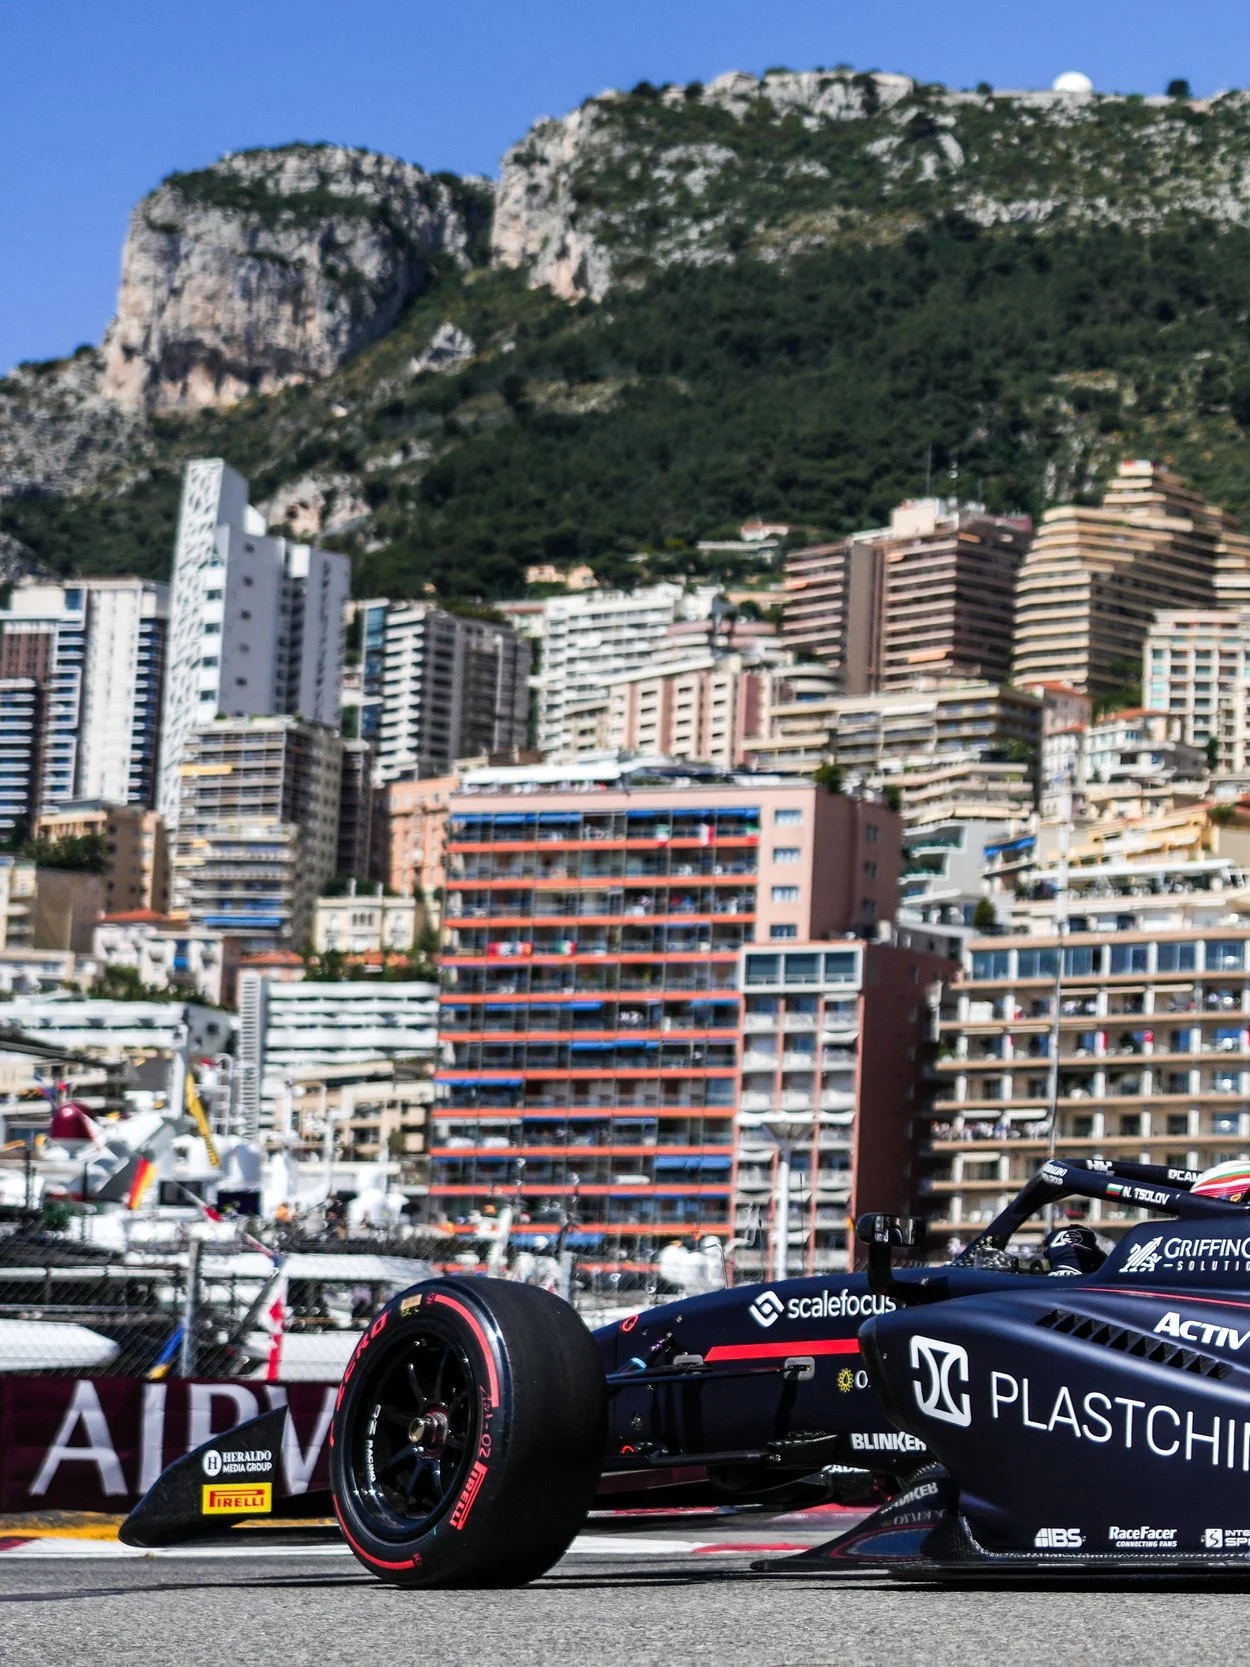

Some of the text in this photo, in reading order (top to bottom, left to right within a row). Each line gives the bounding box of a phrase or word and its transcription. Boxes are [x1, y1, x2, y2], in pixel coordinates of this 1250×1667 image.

[1122, 1185, 1132, 1198] N.
[1133, 1187, 1170, 1205] TSOLOV
[787, 1288, 897, 1319] scalefocus
[221, 1450, 272, 1463] HERALDO
[222, 1462, 273, 1473] MEDIA GROUP
[209, 1489, 265, 1508] PIRELLI
[450, 1460, 489, 1531] PIRELLI
[1109, 1526, 1178, 1541] RaceFacer
[1116, 1540, 1178, 1548] CONNECTING FANS
